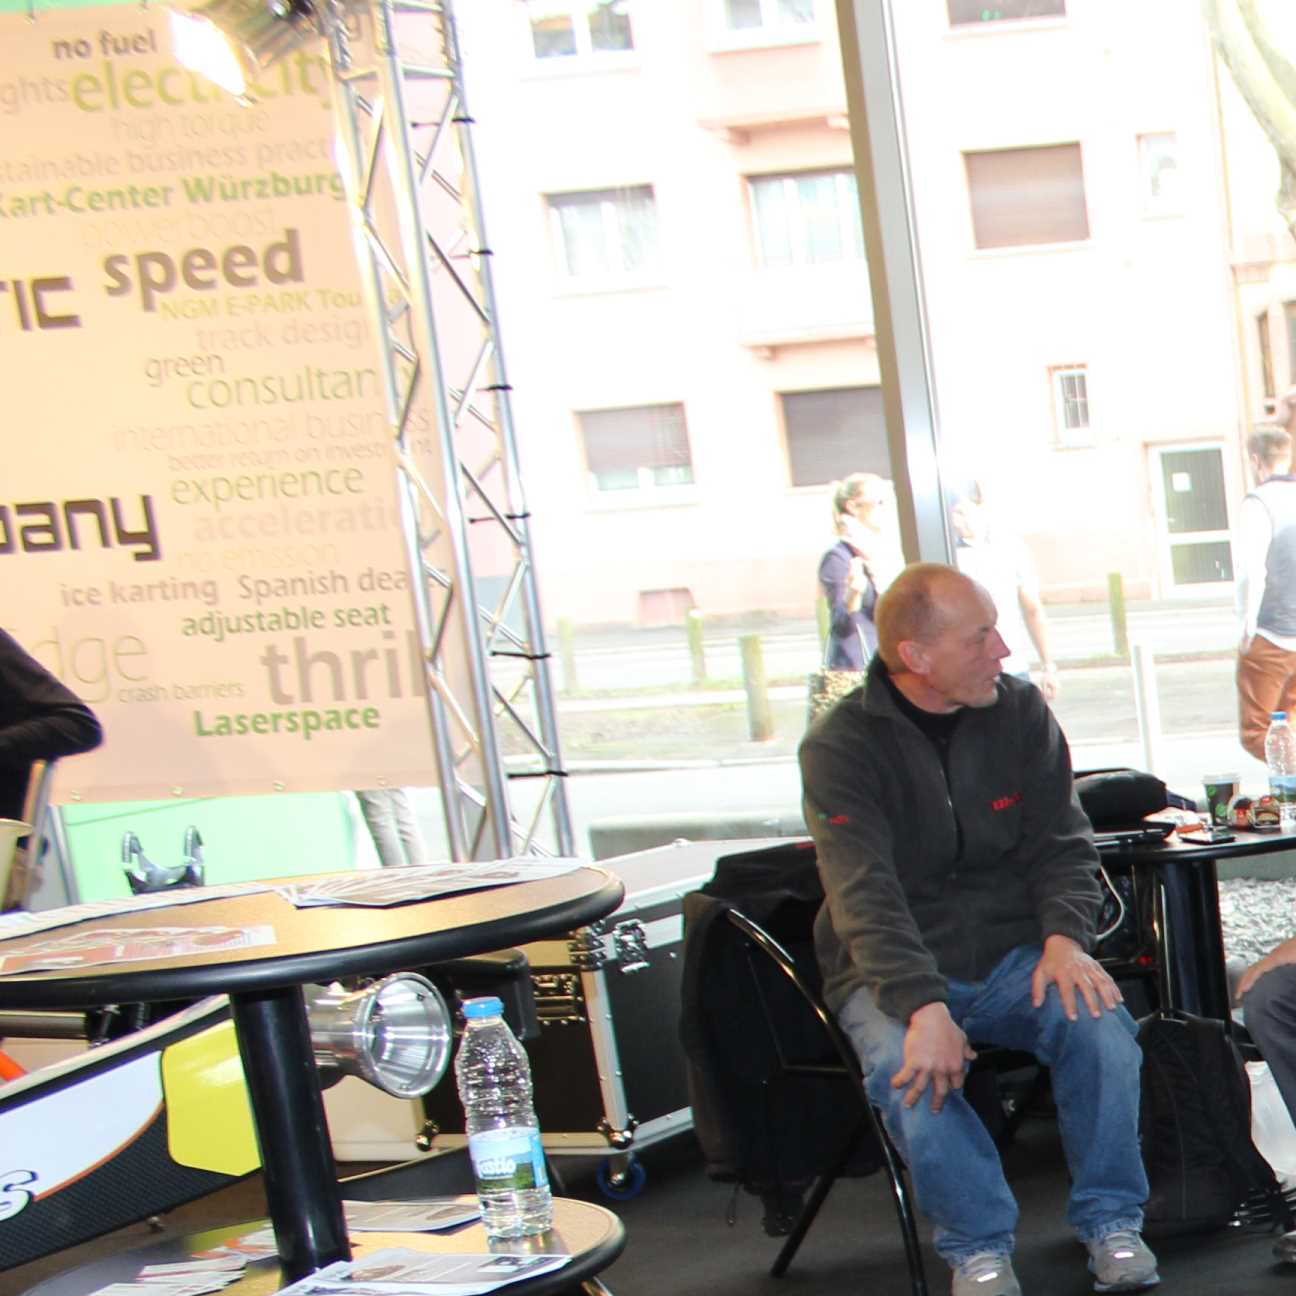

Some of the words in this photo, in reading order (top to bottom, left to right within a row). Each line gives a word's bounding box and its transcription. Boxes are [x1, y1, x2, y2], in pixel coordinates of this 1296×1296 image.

[53, 38, 91, 60] no
[99, 28, 158, 56] fuel
[180, 169, 346, 203] Würzburg
[104, 227, 305, 312] speed
[0, 275, 82, 332] IC
[144, 352, 225, 388] green
[171, 466, 364, 512] experience
[59, 584, 101, 607] ice
[109, 577, 219, 606] karting
[238, 570, 349, 605] Spanish
[181, 604, 325, 643] adjustable
[333, 602, 391, 629] seat
[193, 706, 381, 740] Laserspace
